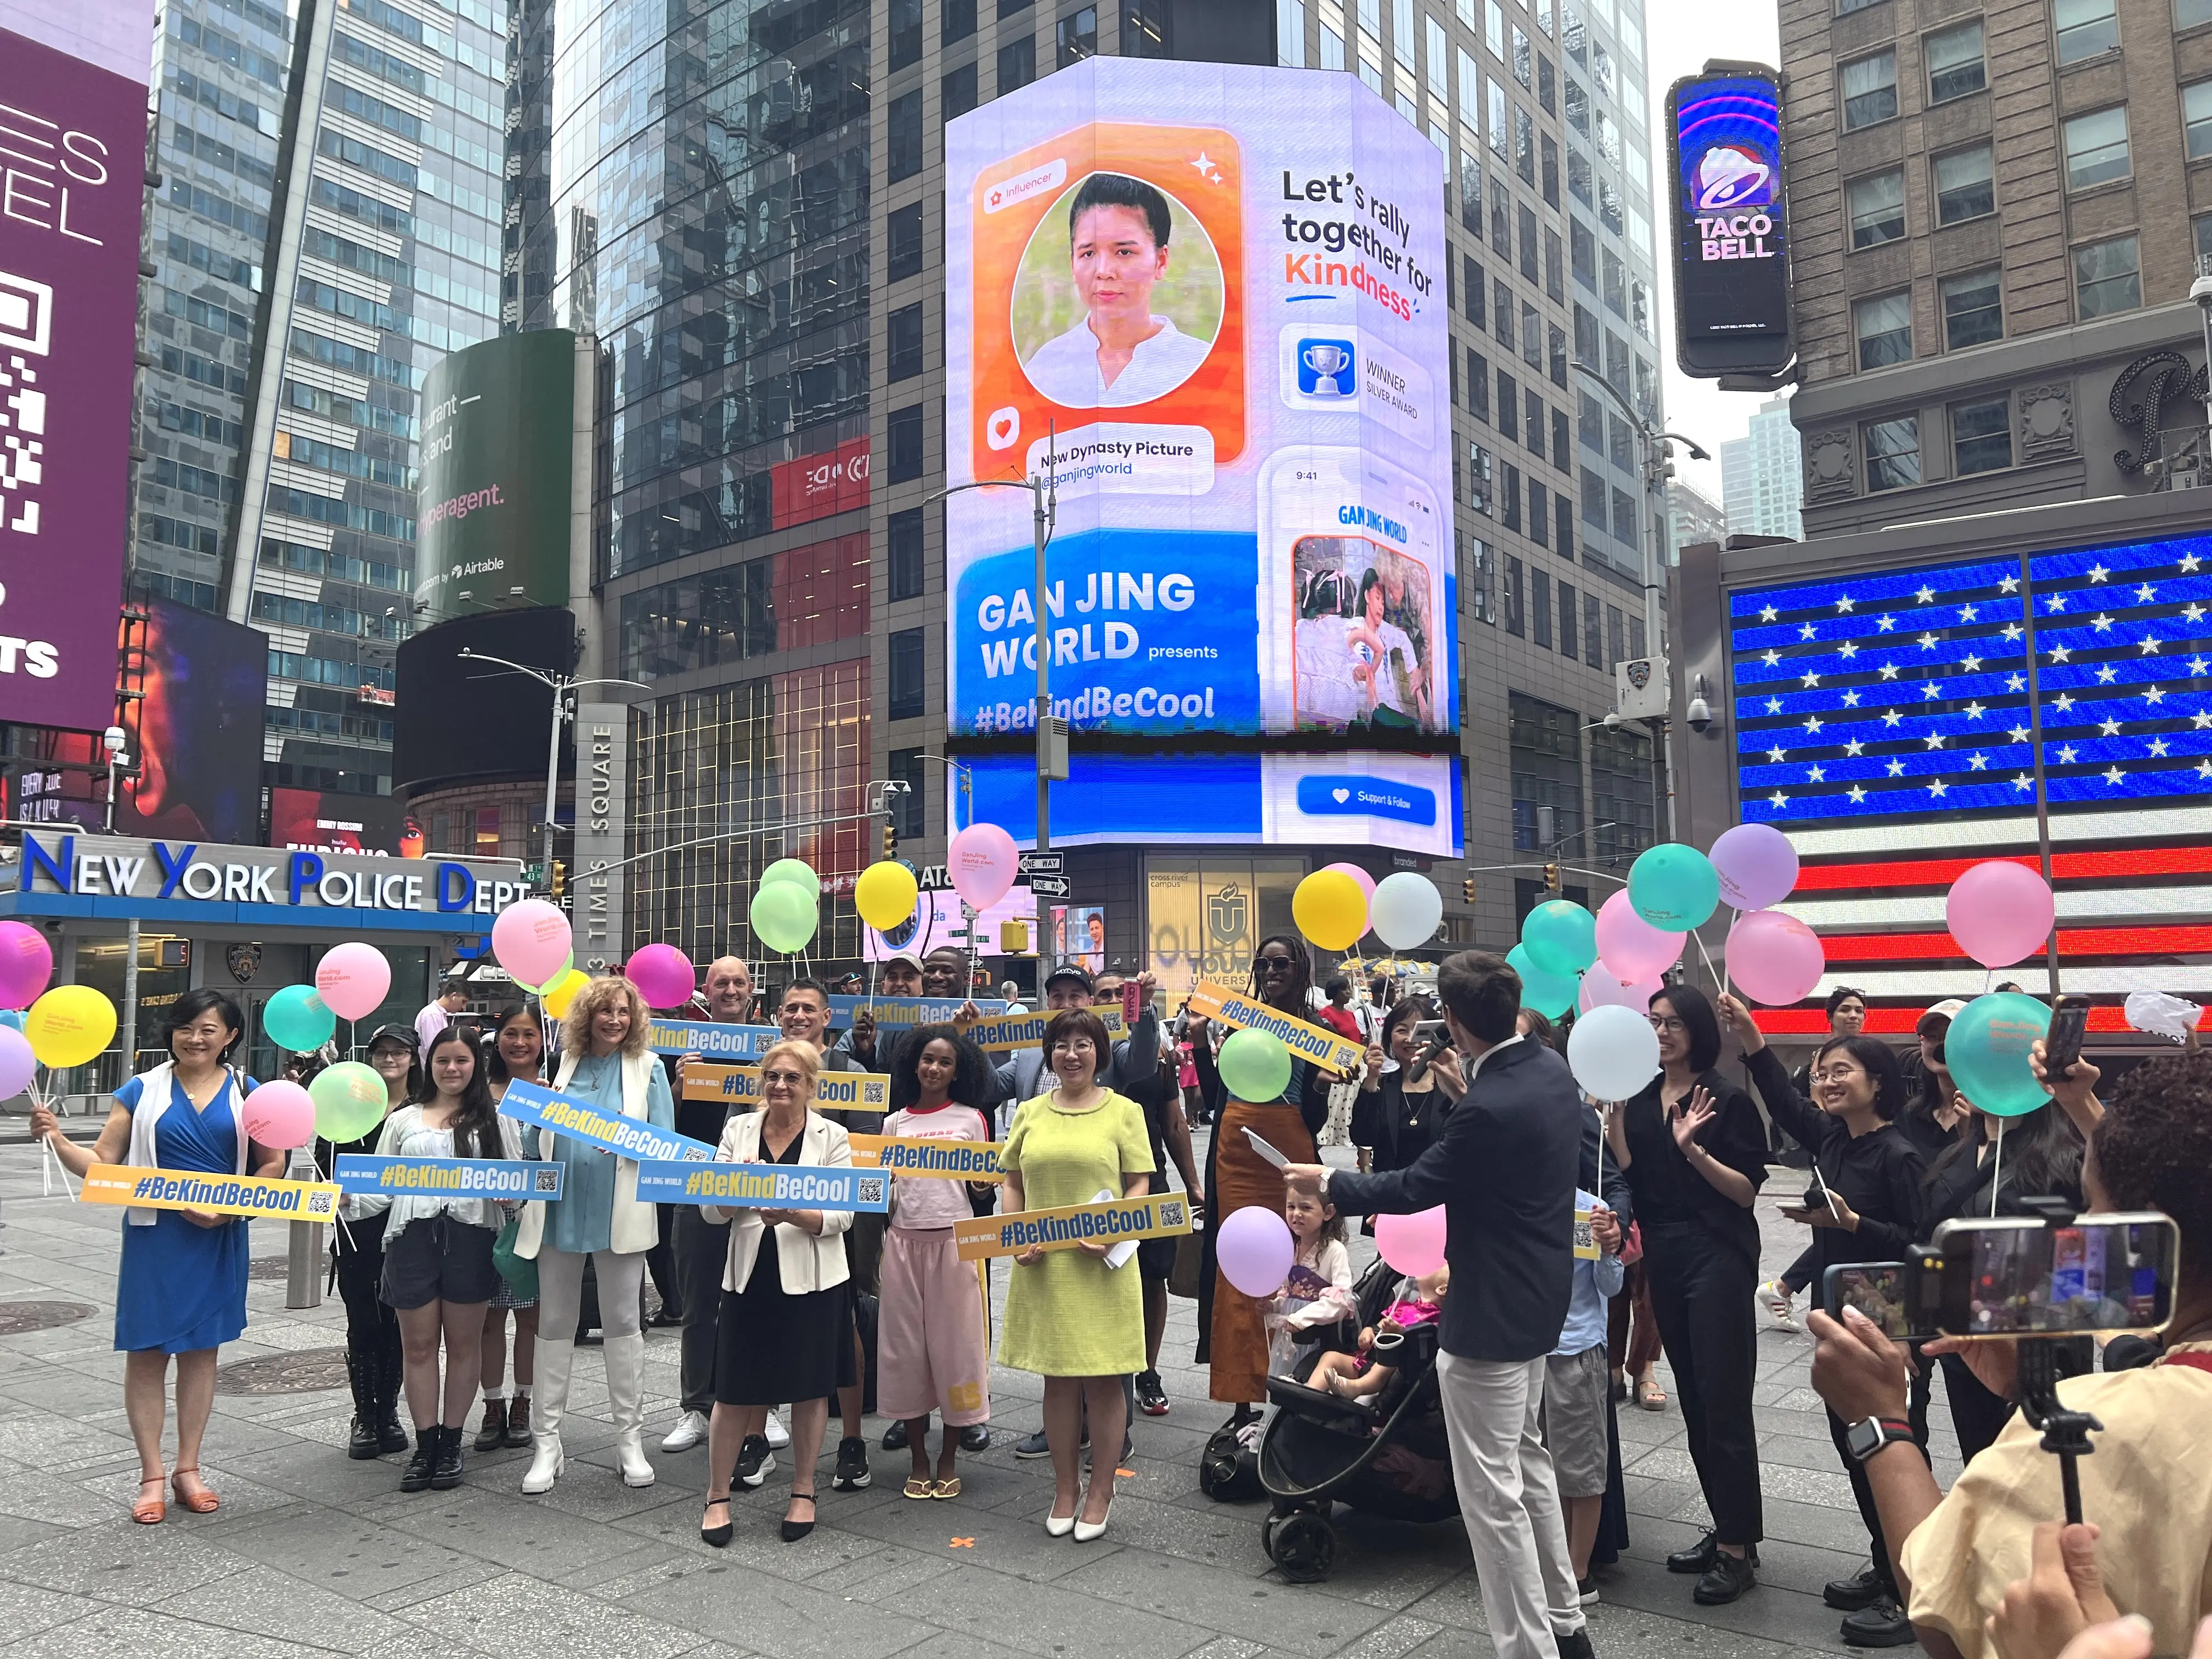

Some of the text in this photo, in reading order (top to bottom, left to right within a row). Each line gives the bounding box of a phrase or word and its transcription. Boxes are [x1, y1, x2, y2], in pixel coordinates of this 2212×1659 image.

[1006, 173, 1052, 198] Influencer
[0, 166, 104, 246] EL
[1283, 171, 1409, 249] Let's rally
[1695, 214, 1772, 239] TACO
[1282, 213, 1432, 297] together for
[1702, 237, 1773, 261] BELL
[1285, 253, 1410, 321] Kindness
[1367, 358, 1406, 395] WINNER
[1367, 381, 1418, 419] SILVER AWARD
[430, 426, 452, 460] and
[1041, 441, 1193, 468] New Dynasty Picture
[1042, 463, 1132, 490] @ganjingworld
[1296, 472, 1317, 480] 9:41
[1339, 506, 1407, 544] GAN JING WORLD
[442, 572, 448, 583] by
[464, 557, 504, 575] Airtable
[978, 572, 1195, 631] GAN JING
[981, 621, 1218, 679] WORLD presents
[1358, 791, 1410, 809] Support & Follow
[317, 819, 363, 831] EMMY ROSSUM
[587, 726, 611, 970] 3 TIMES SQUARE
[1042, 859, 1057, 868] WAY
[1394, 856, 1417, 867] branded
[21, 831, 146, 896] NEW
[151, 842, 278, 902] YORK
[289, 851, 423, 911] POLICE
[1035, 881, 1062, 891] ONE WAY
[481, 966, 511, 980] CH
[966, 1019, 1048, 1045] #BeKindB
[1219, 999, 1334, 1059] #BeKindBeCool
[507, 1093, 681, 1160] GAN JING WORLD #BeKindBeCool
[133, 1176, 302, 1211] #BeKindBeCool
[380, 1164, 529, 1192] #BeKindBeCool
[641, 1170, 850, 1203] GAN JING WORLD #BeKindBeCool
[959, 1204, 1153, 1248] GAN JING WORLD #BeKindBeCool
